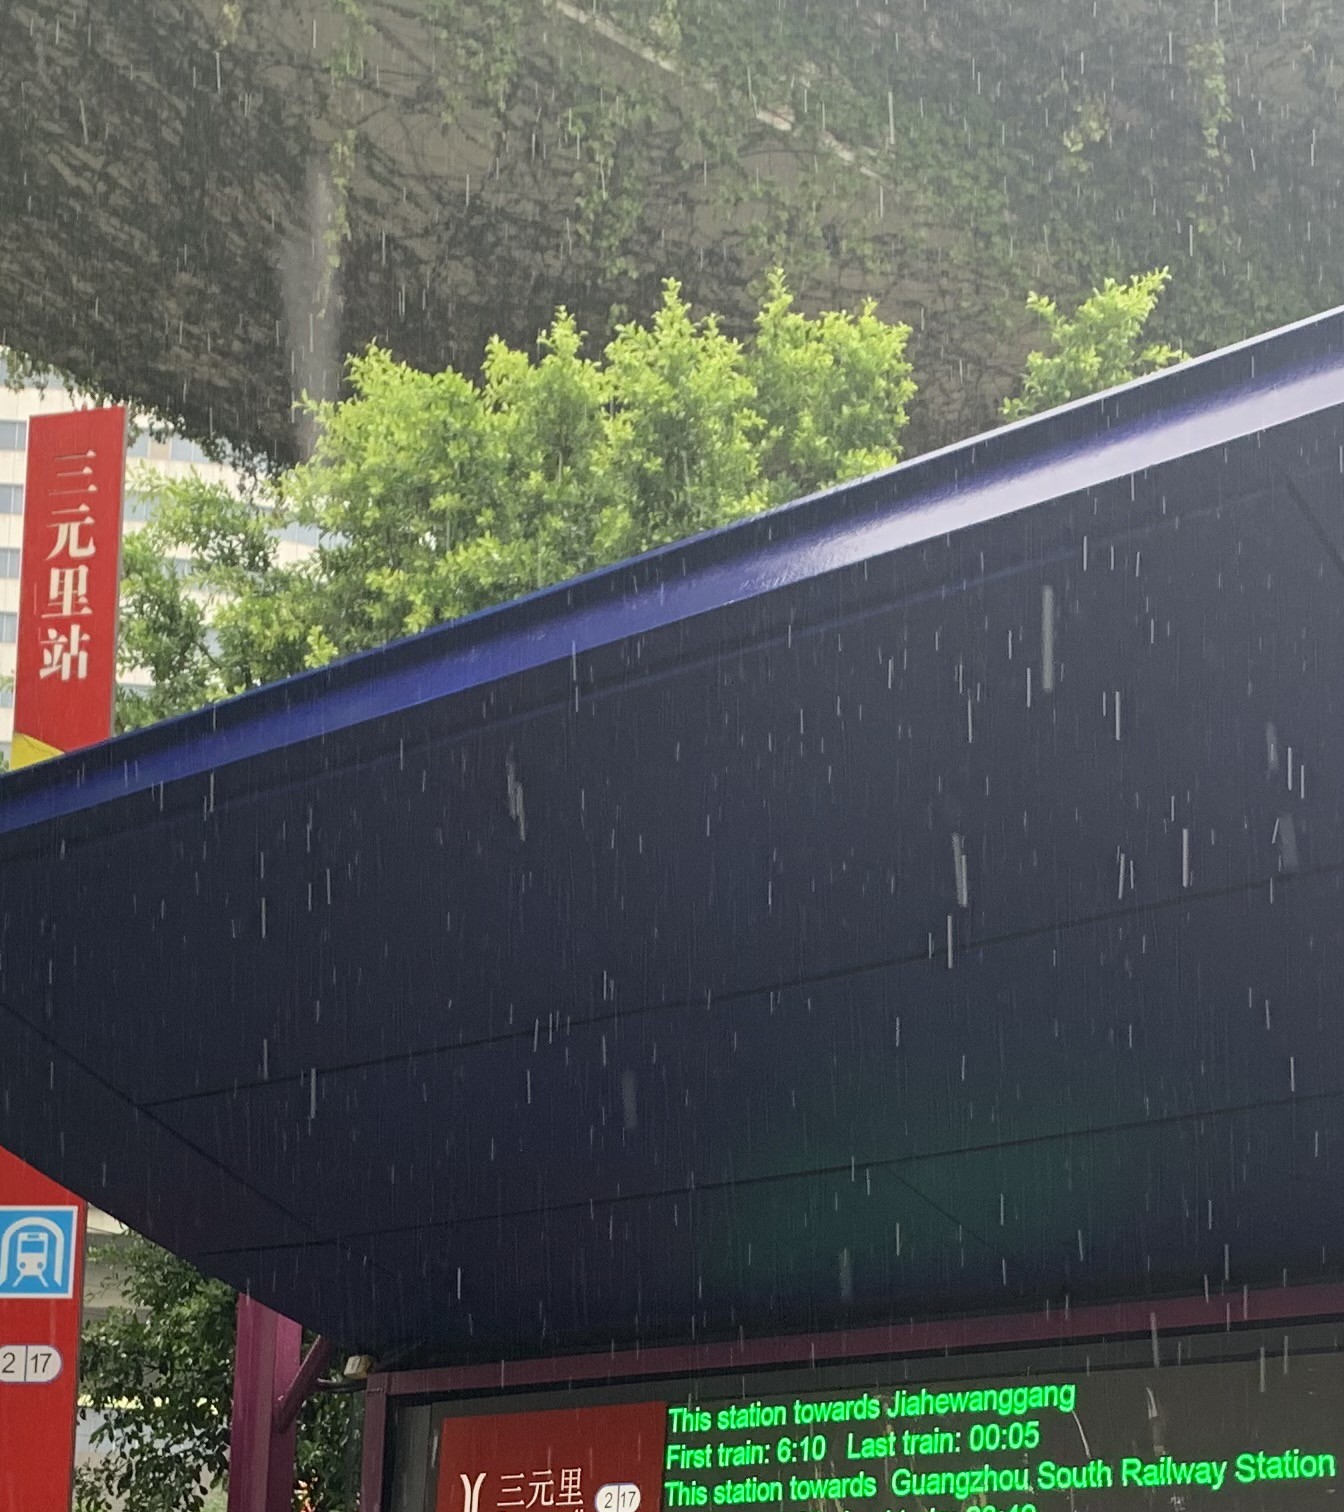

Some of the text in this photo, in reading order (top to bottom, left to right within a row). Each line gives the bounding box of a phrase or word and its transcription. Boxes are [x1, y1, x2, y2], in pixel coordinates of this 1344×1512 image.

[40, 449, 97, 681] 三元里站
[2, 1352, 52, 1374] 2 17
[669, 1384, 1076, 1432] This station towards Jiahewanggang
[666, 1420, 1041, 1469] First train: 6:10 Last train: 00:05
[496, 1467, 637, 1509] 三元里 2 17
[665, 1448, 1336, 1506] This station towards Guangzhou South Railway Station
